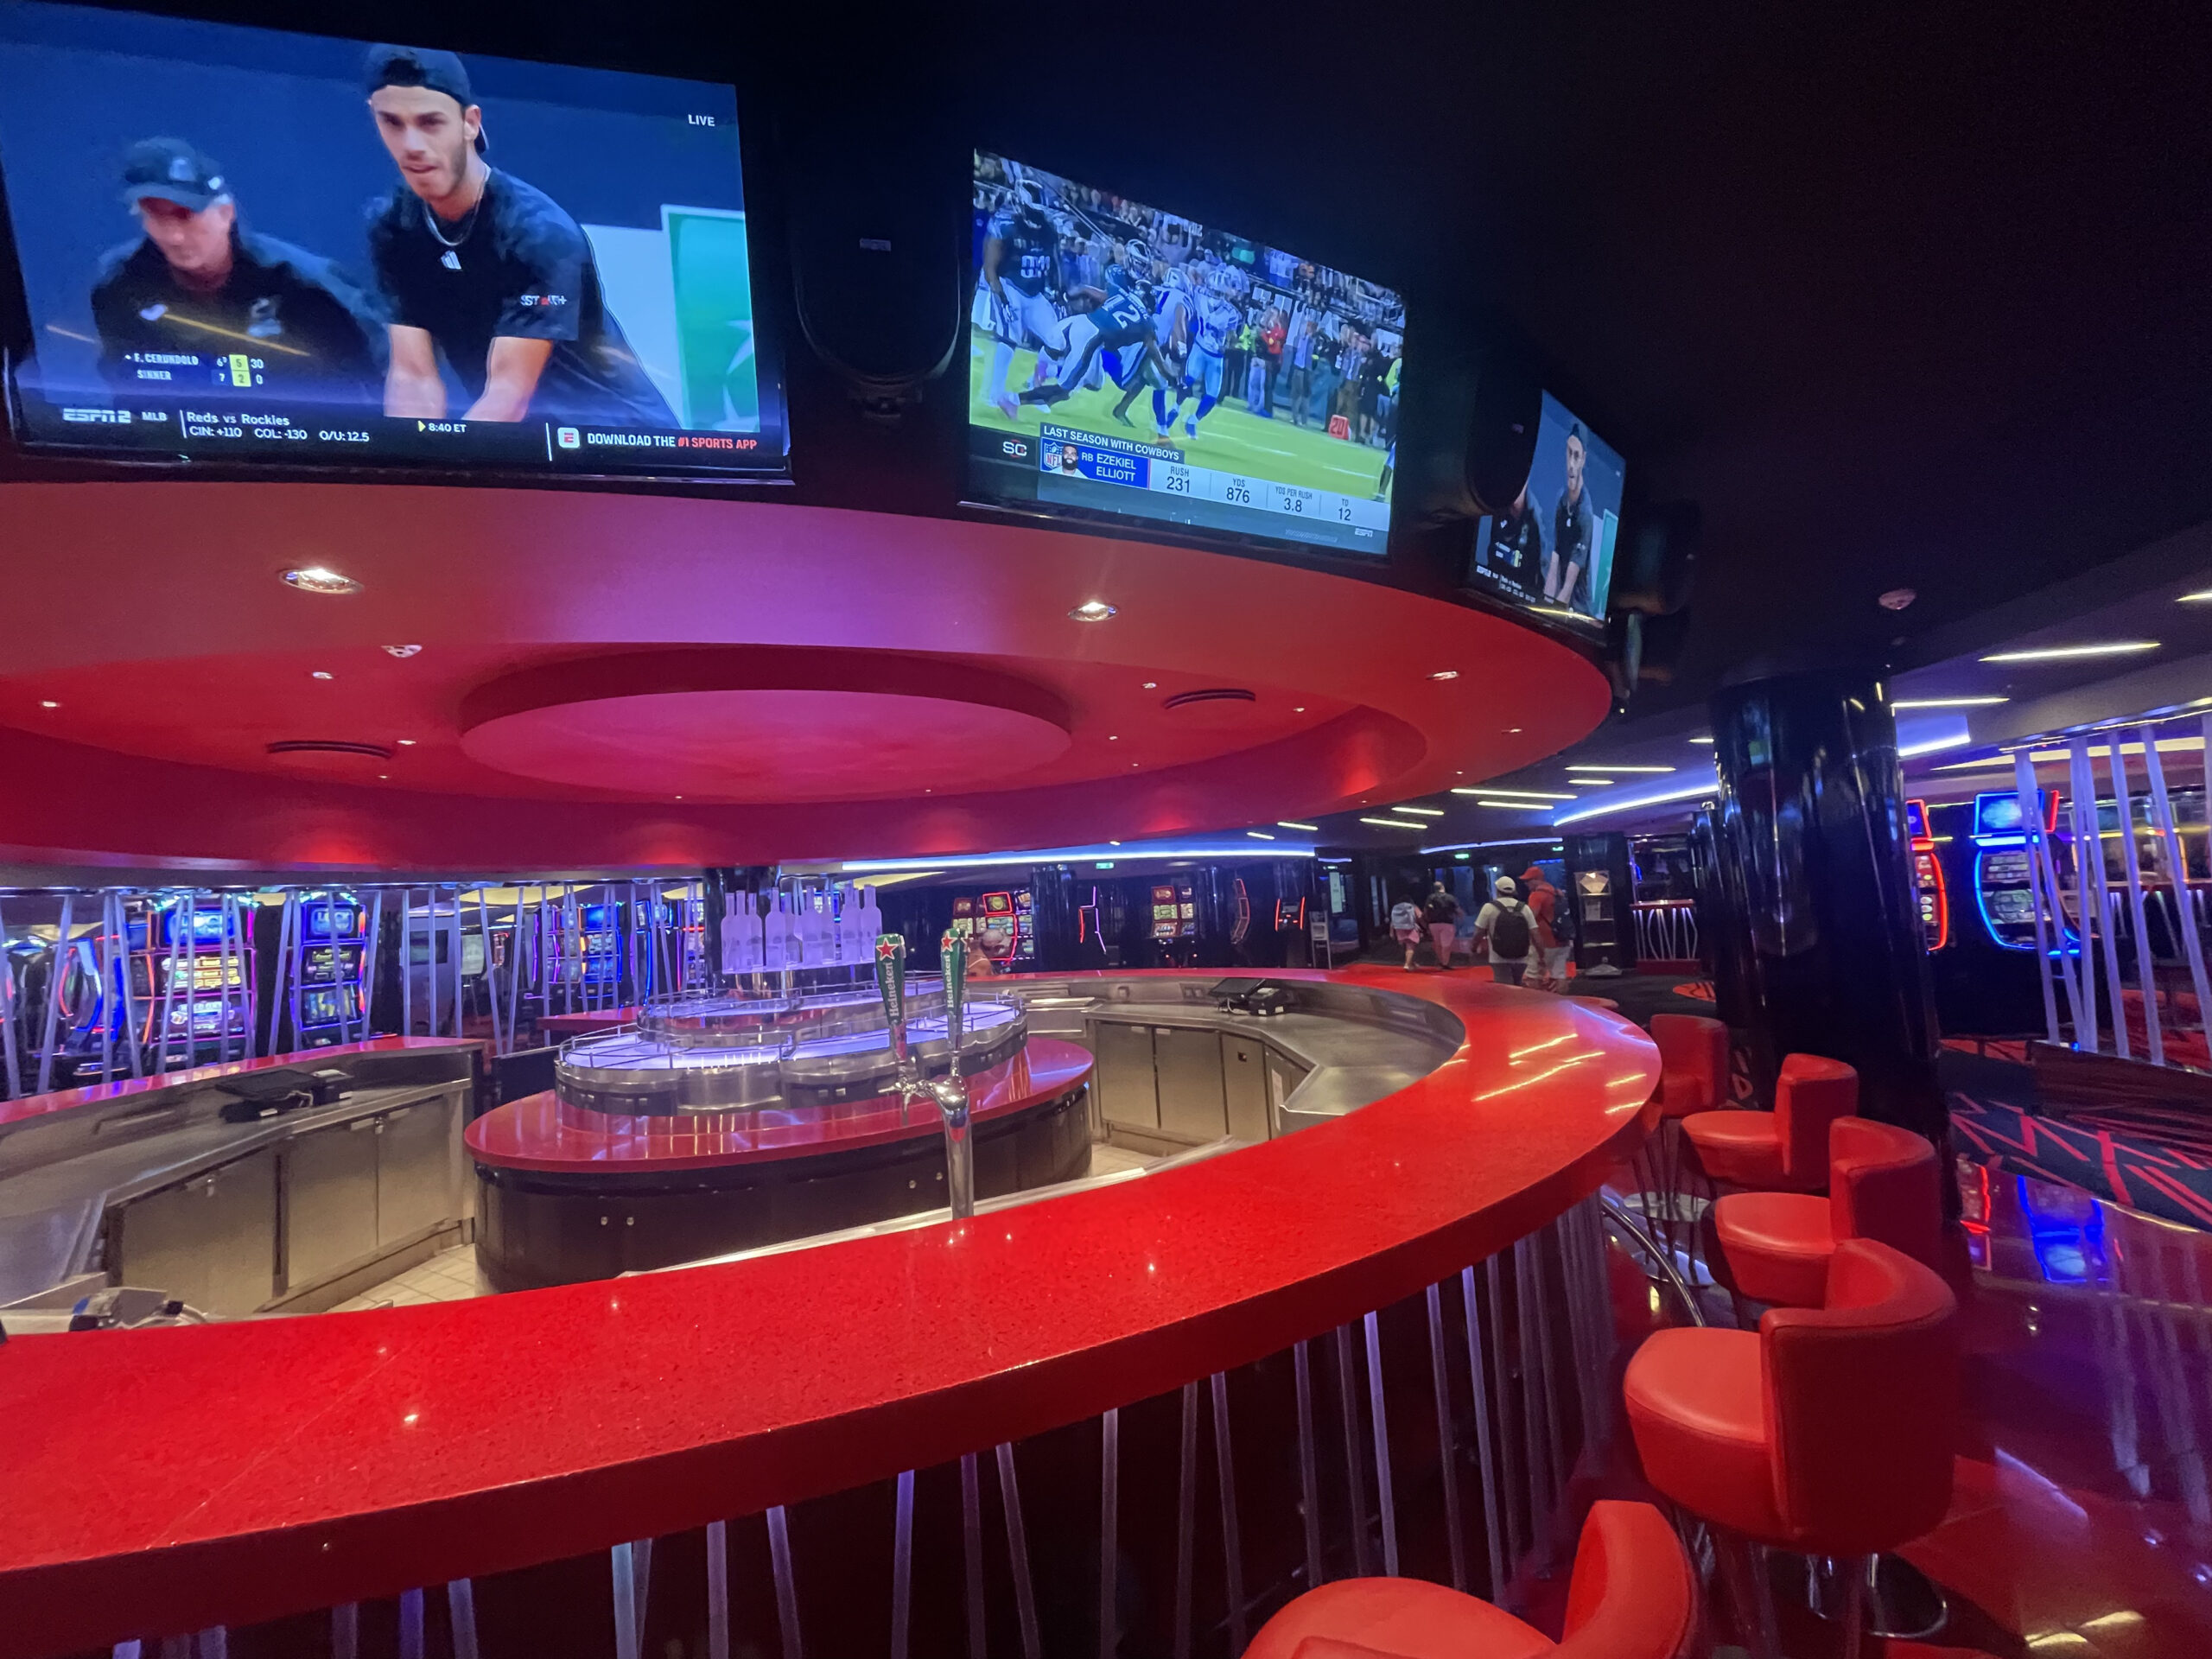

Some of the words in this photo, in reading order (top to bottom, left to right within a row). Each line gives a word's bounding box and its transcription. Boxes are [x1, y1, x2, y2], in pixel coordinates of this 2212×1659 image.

[688, 114, 715, 127] LIVE
[250, 358, 264, 369] 30
[255, 373, 264, 385] 0
[62, 408, 132, 423] ESPN2
[142, 410, 168, 422] MLB
[186, 411, 219, 423] Reds
[222, 414, 237, 424] vs
[241, 413, 290, 426] Rockies
[188, 426, 214, 437] CIN:
[217, 427, 243, 438] +110
[254, 428, 283, 439] COL:
[283, 429, 308, 440] -130
[319, 430, 345, 442] O/U:
[347, 431, 370, 442] 12.5
[428, 422, 452, 433] 8:40
[453, 423, 467, 434] ET
[587, 432, 652, 447] DOWNLOAD
[652, 435, 676, 448] THE
[677, 437, 690, 448] #1
[691, 437, 734, 449] SPORTS
[735, 439, 758, 450] APP
[1002, 441, 1027, 456] SC
[1044, 425, 1069, 439] LAST
[1070, 431, 1109, 447] SEASON
[1110, 438, 1134, 451] WITH
[1135, 443, 1179, 461] COWBOYS
[1046, 453, 1062, 467] NFL
[1081, 451, 1094, 462] RB
[1096, 453, 1137, 470] EZEKIEL
[1096, 466, 1136, 482] ELLIOTT
[1170, 466, 1190, 477] RUSH
[1166, 476, 1191, 493] 231
[1232, 478, 1246, 488] YDS
[1226, 486, 1250, 504] 876
[1287, 488, 1298, 498] PER
[1284, 498, 1302, 512] 3.8
[1338, 507, 1351, 522] 12
[944, 954, 954, 1008] Heineken
[883, 961, 899, 1017] Heineken
